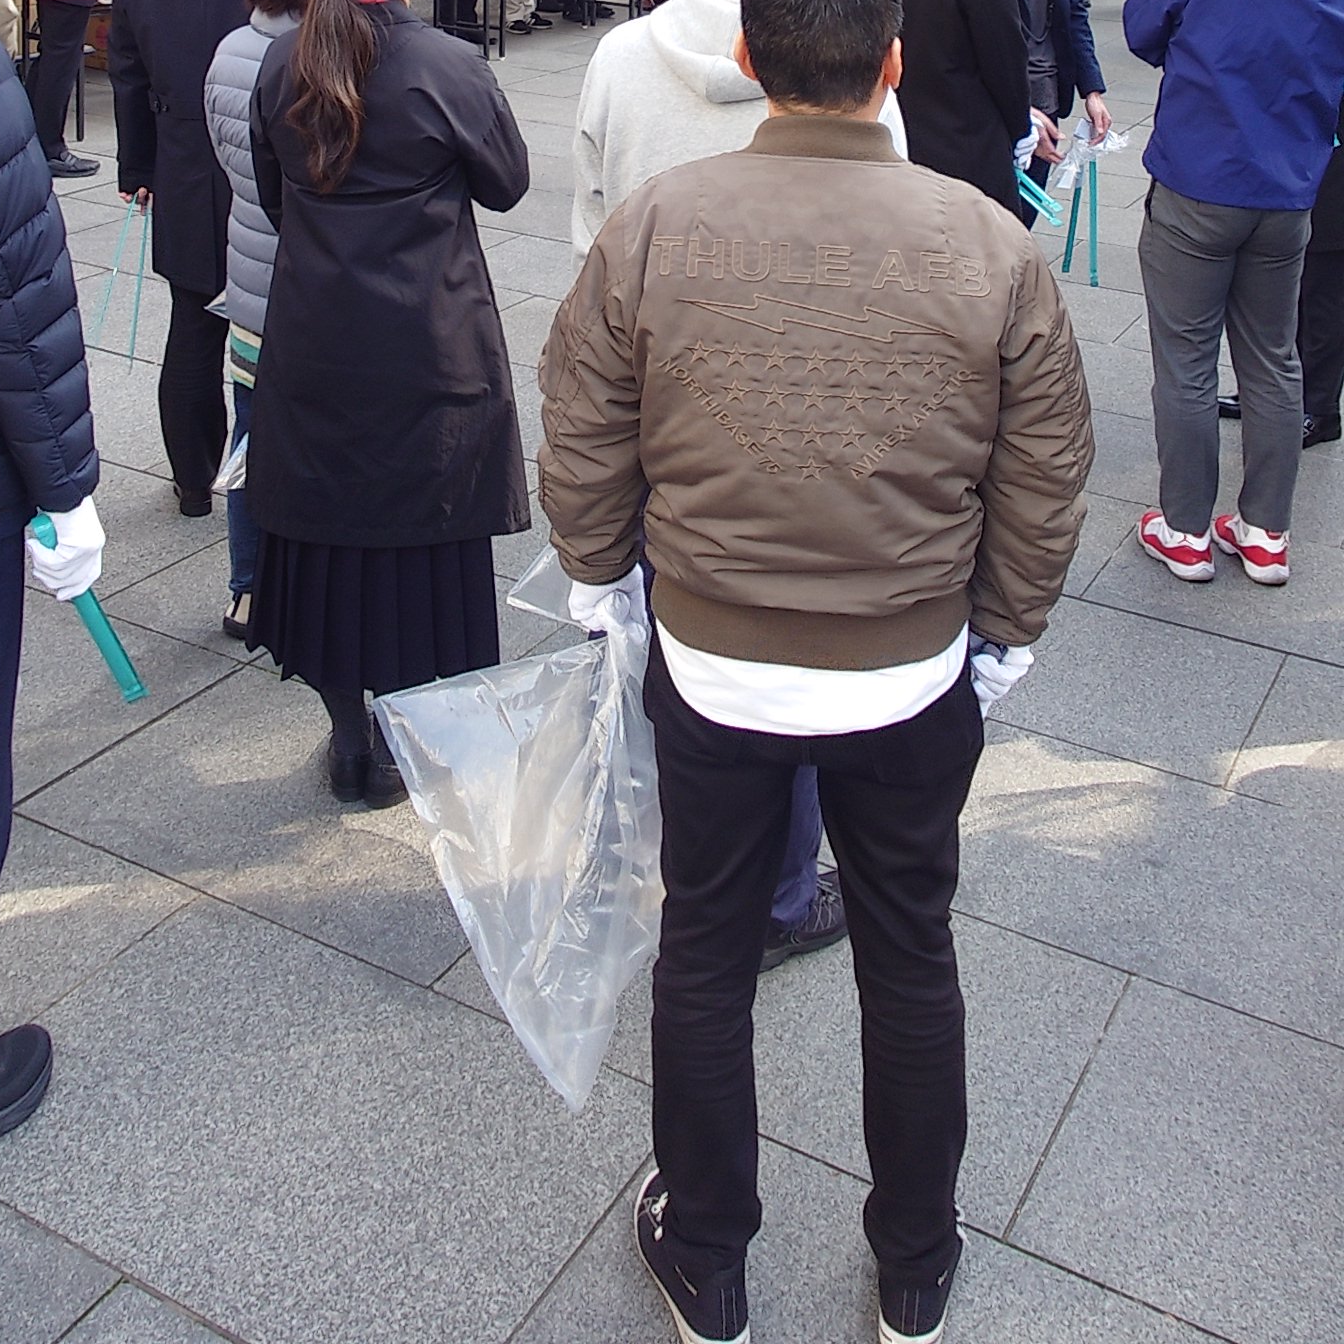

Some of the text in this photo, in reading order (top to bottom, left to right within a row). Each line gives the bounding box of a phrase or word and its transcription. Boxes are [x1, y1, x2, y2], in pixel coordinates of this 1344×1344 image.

[652, 235, 992, 297] THULE AFB
[658, 357, 720, 412] NORTH
[714, 411, 766, 457] BASE
[850, 369, 974, 480] AVIREX ARCTIC
